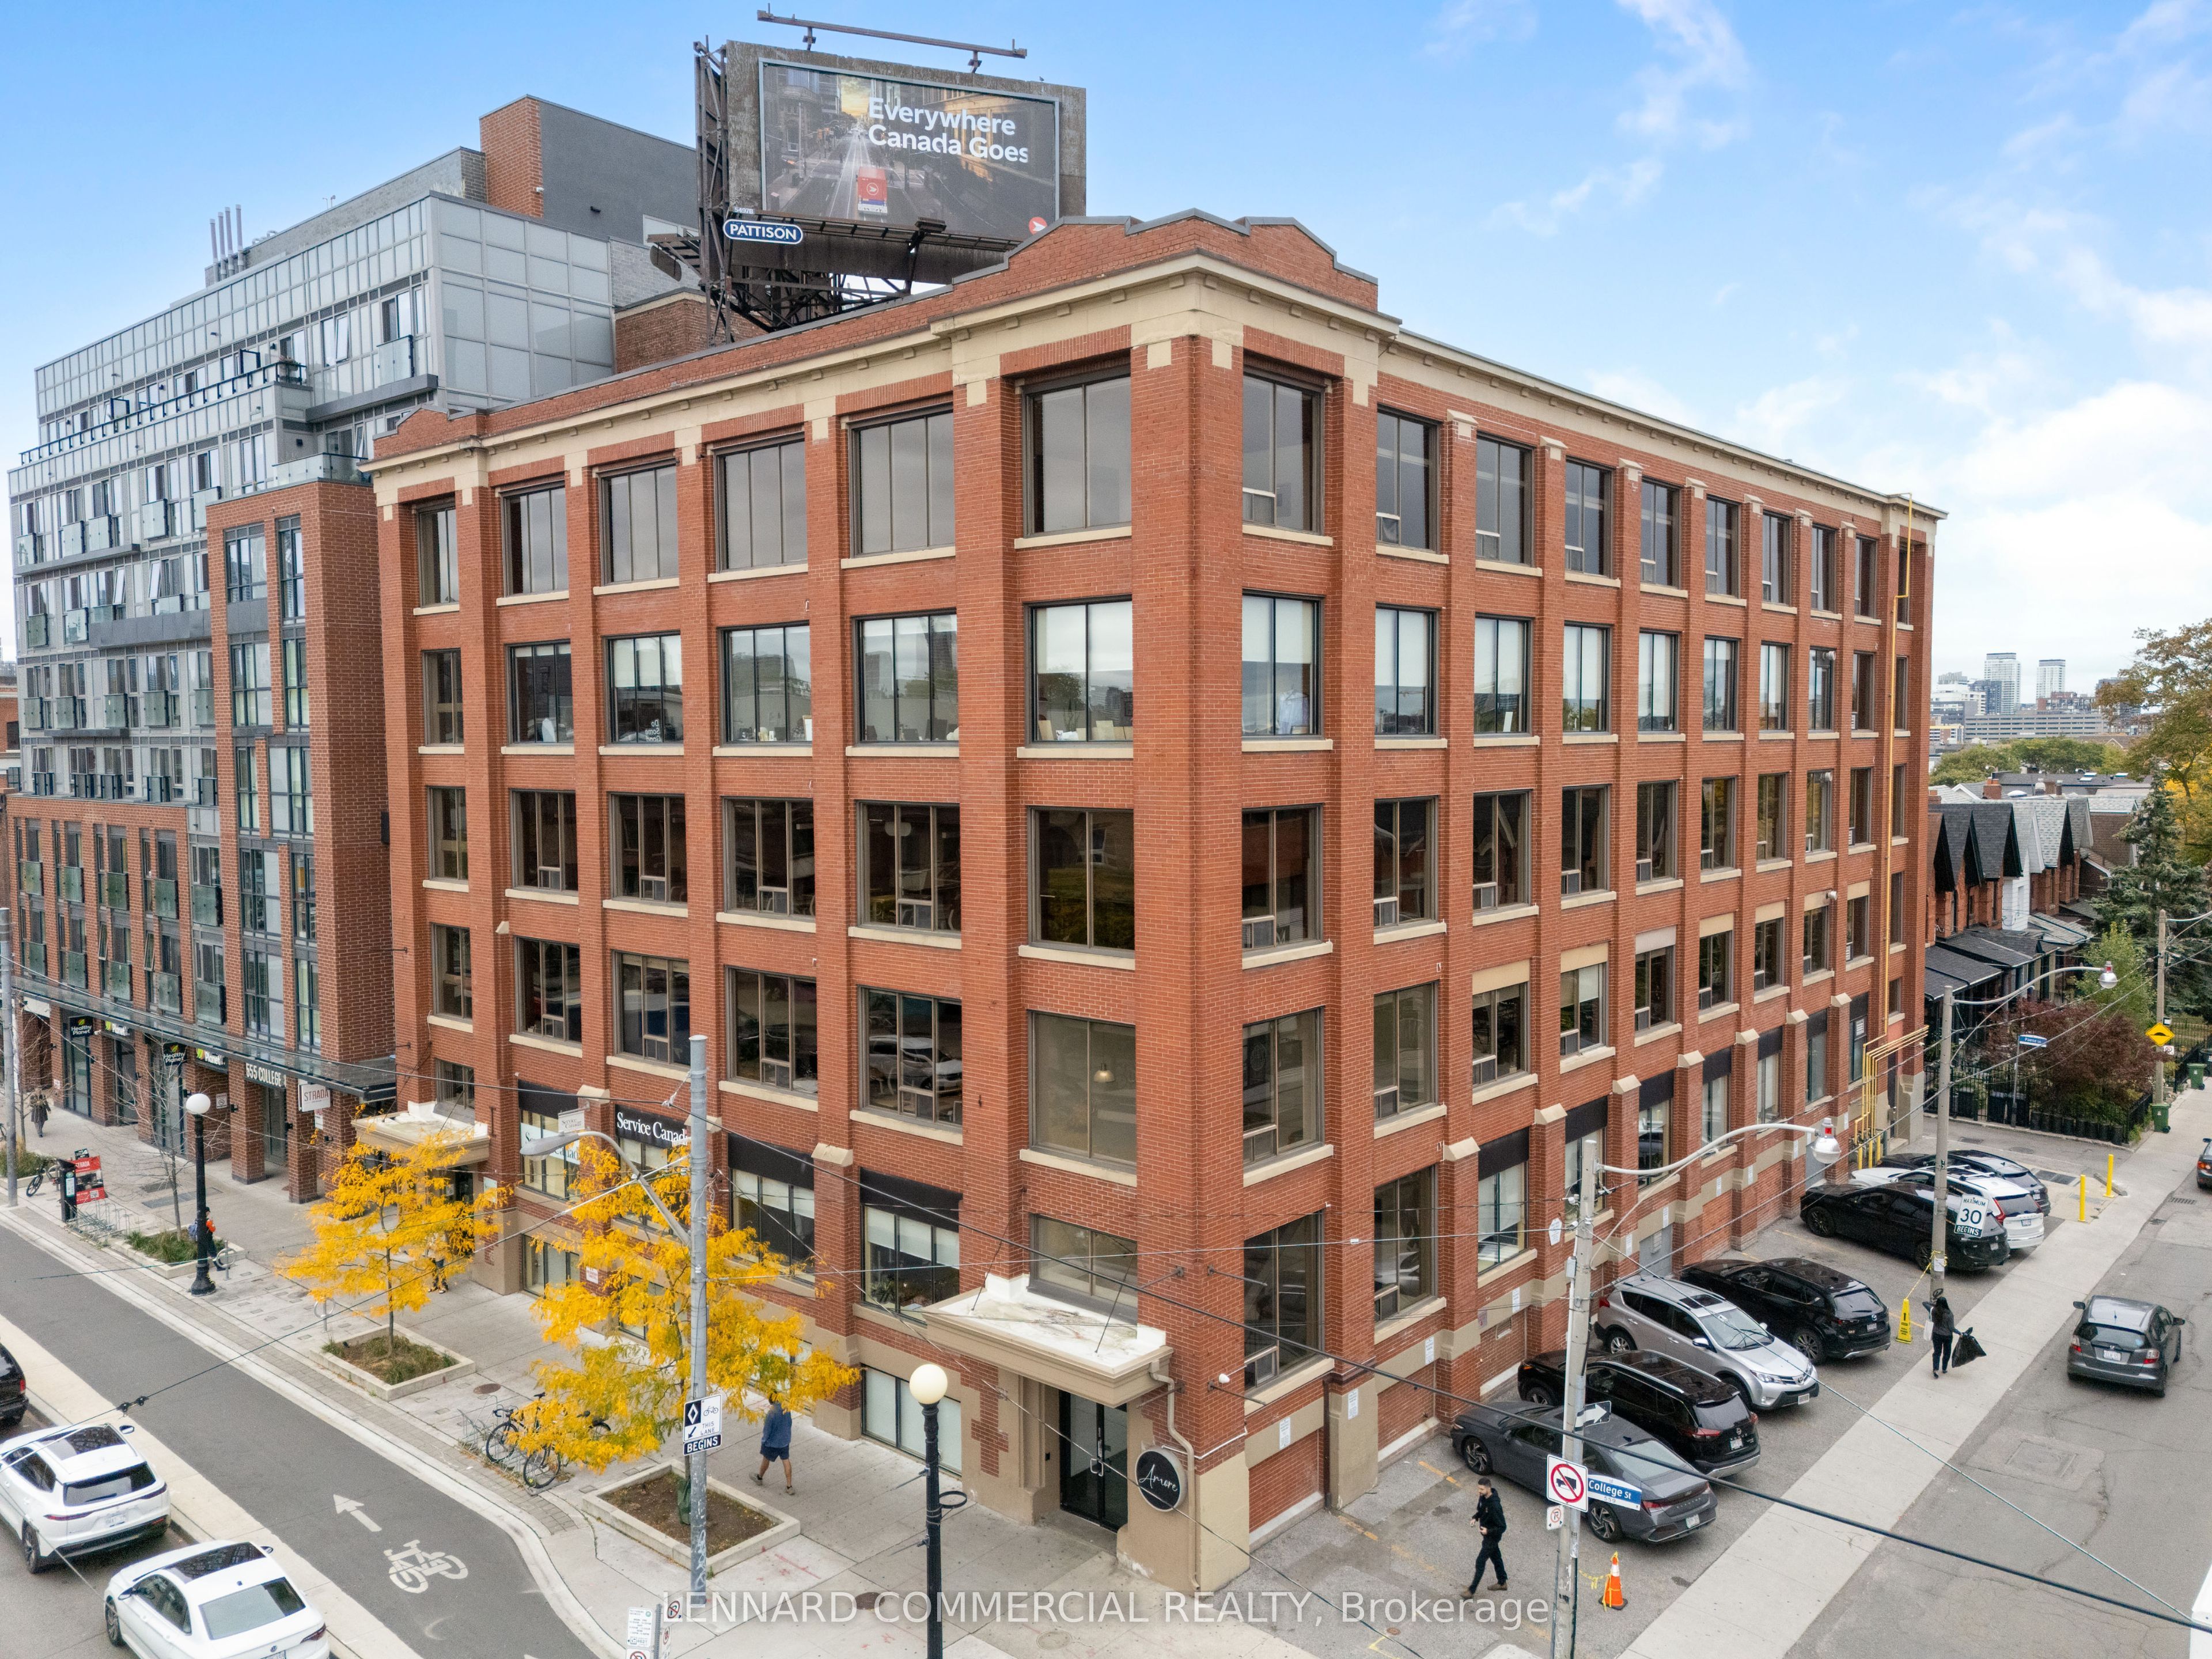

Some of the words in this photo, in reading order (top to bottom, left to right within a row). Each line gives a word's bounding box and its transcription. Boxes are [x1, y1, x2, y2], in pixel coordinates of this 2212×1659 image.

[869, 97, 1016, 136] Everywhere
[868, 124, 962, 156] Canada
[969, 137, 1028, 163] Goes
[730, 224, 797, 240] PATTISON
[246, 1063, 257, 1080] 555
[259, 1067, 282, 1088] COLLEGE
[304, 1089, 329, 1101] STRADA
[565, 1121, 581, 1129] Canada
[617, 1112, 651, 1136] Service
[653, 1122, 687, 1142] Canad
[1963, 1199, 1986, 1207] MAXIMUM
[1960, 1209, 1982, 1225] 30
[1957, 1225, 1979, 1236] BEGINS
[700, 1427, 715, 1435] LANE
[702, 1421, 714, 1429] THIS
[687, 1437, 718, 1453] BEGINS
[1139, 1464, 1178, 1491] Amore
[1589, 1480, 1622, 1497] College
[1624, 1491, 1631, 1500] St
